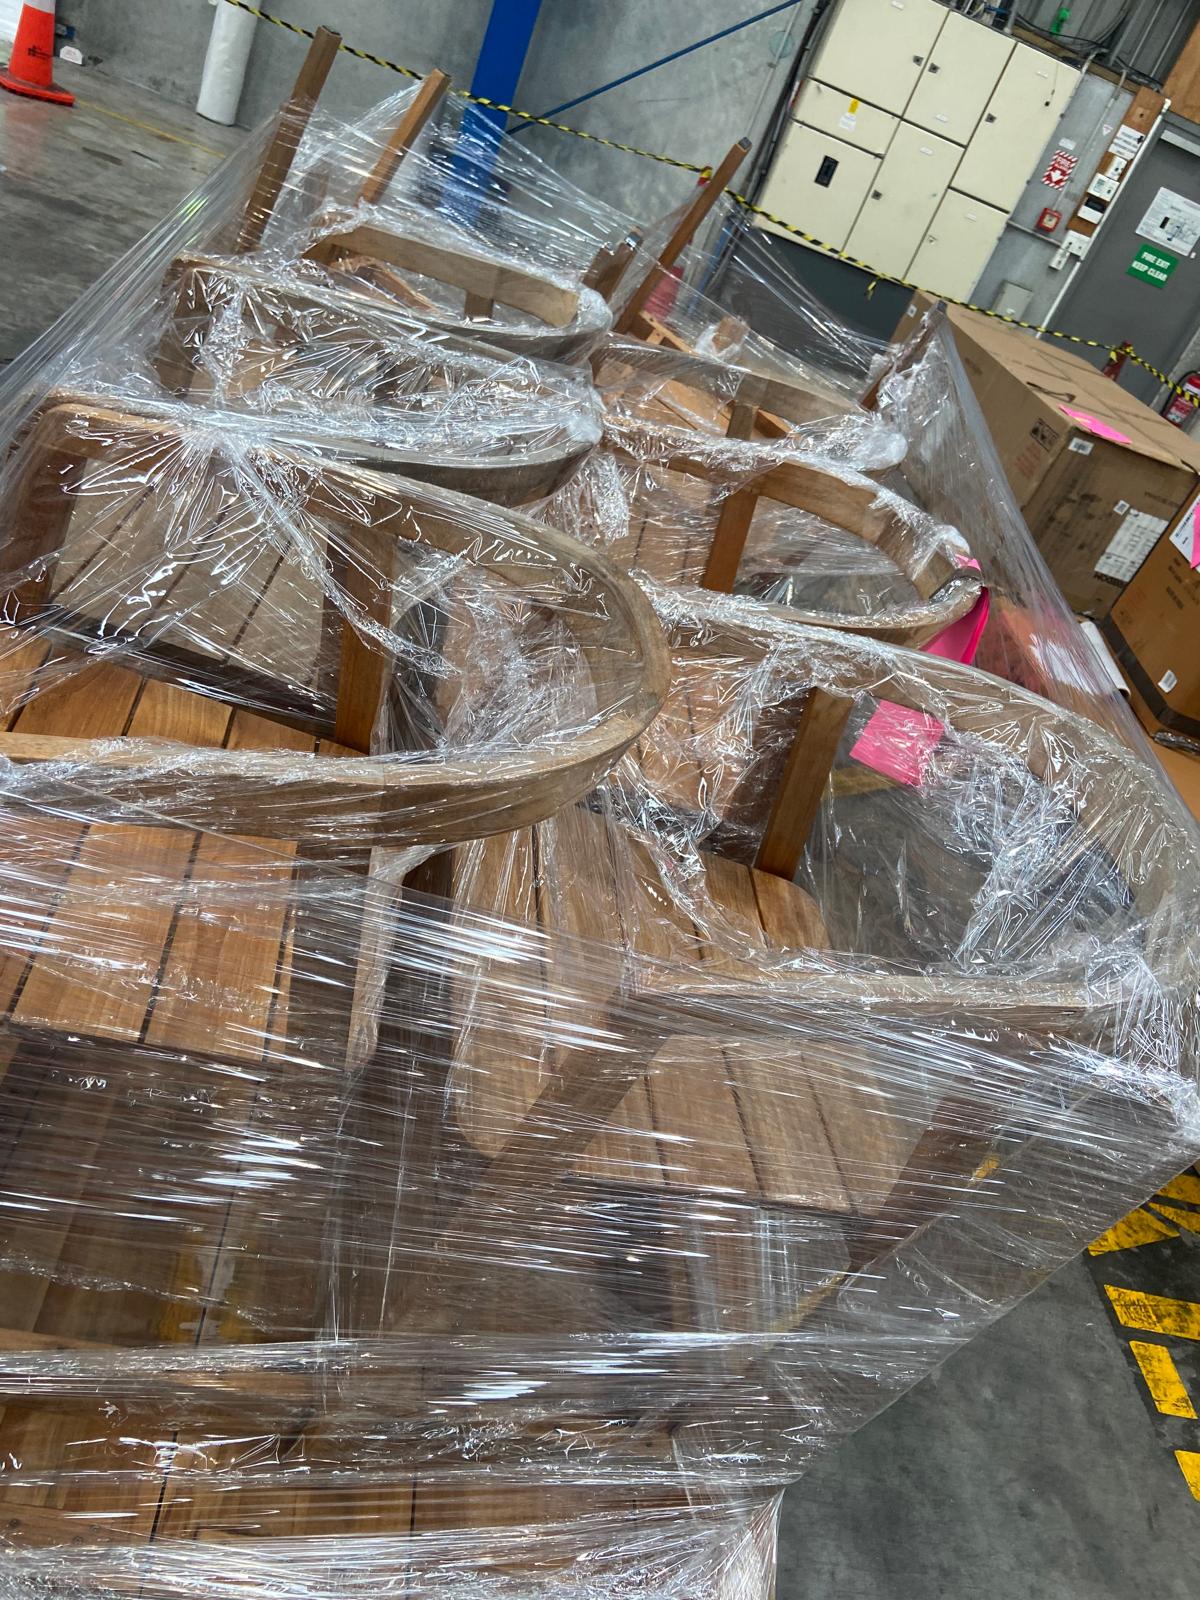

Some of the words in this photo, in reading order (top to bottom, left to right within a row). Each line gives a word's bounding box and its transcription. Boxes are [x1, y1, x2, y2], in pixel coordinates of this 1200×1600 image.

[1056, 156, 1071, 169] FIRE
[1141, 251, 1158, 264] FIRE
[1155, 258, 1170, 270] EXIT
[1131, 260, 1149, 272] KEEP
[1147, 267, 1168, 282] CLEAR
